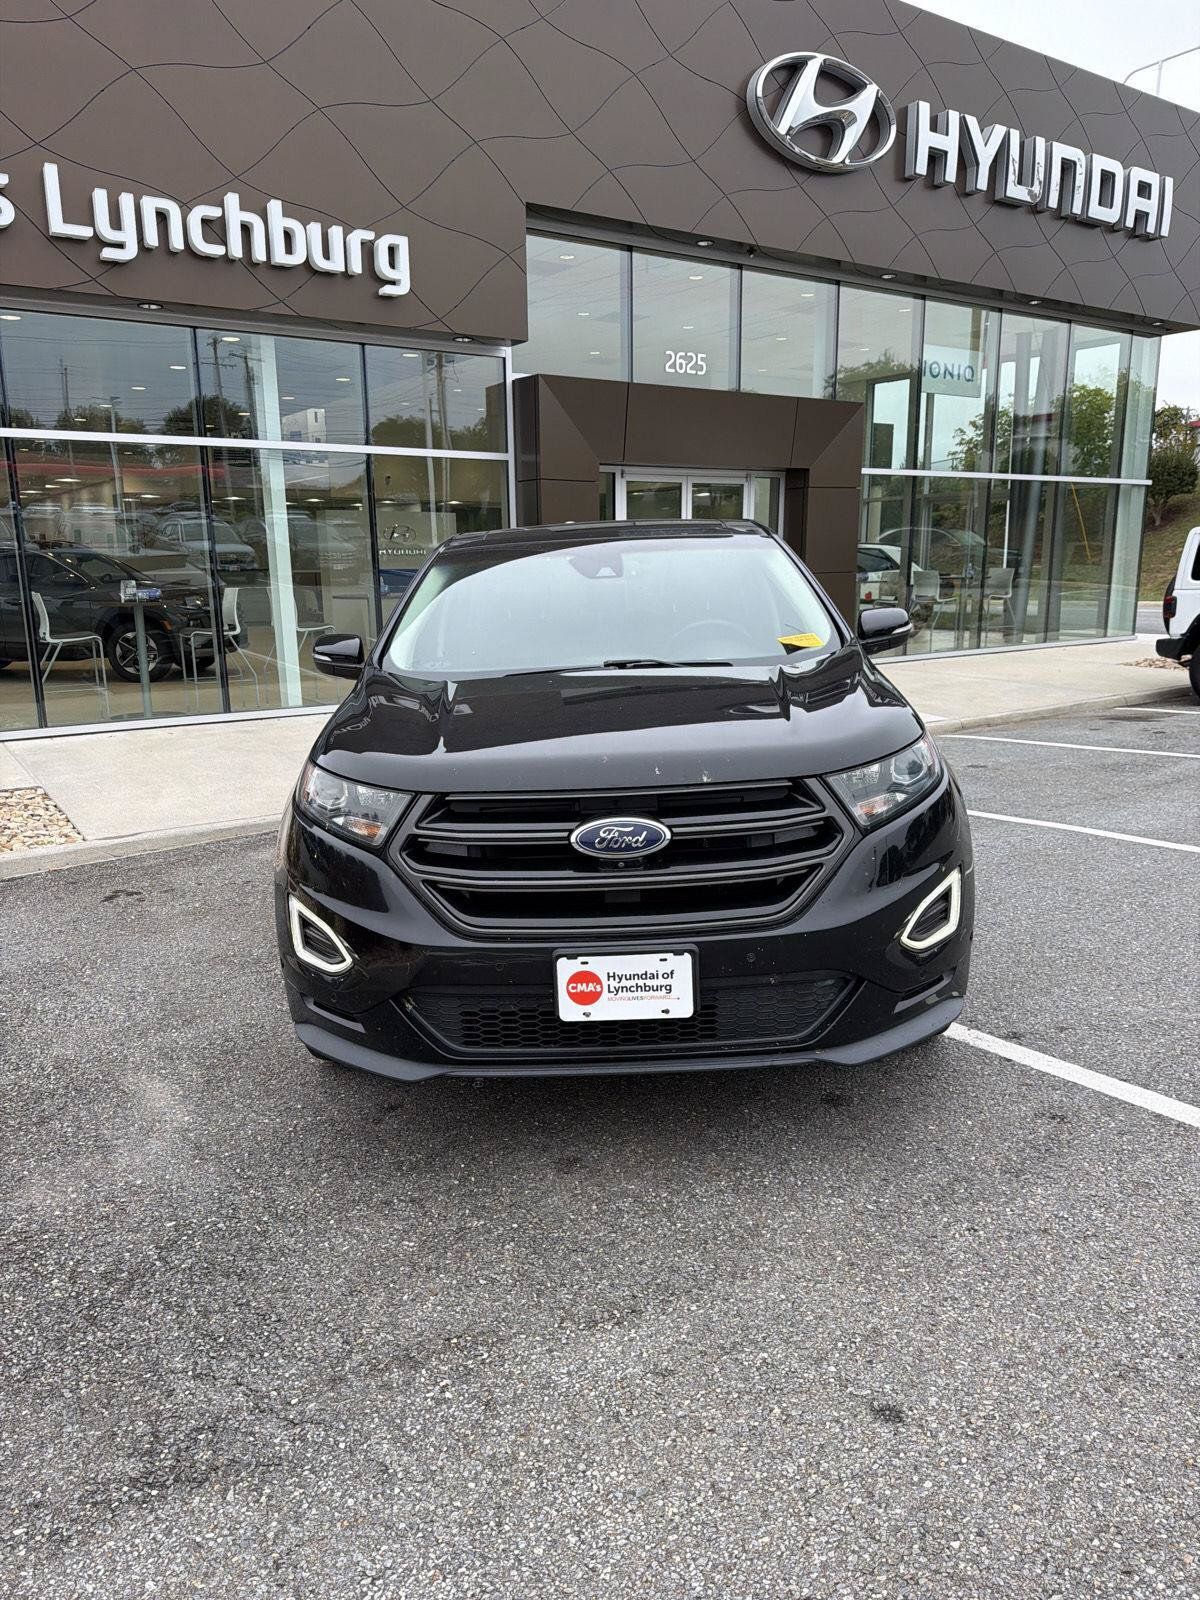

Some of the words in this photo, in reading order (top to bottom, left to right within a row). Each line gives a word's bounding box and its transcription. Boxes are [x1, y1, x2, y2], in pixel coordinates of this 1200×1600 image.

[905, 100, 1174, 238] HYUNDAI
[42, 162, 411, 297] Lynchburg
[665, 350, 707, 376] 2625
[923, 360, 975, 383] IONIQ
[594, 826, 648, 849] Ford
[568, 983, 602, 993] CMA's
[606, 971, 659, 984] Hyundai
[661, 969, 675, 980] of
[607, 983, 673, 995] Lynchburg
